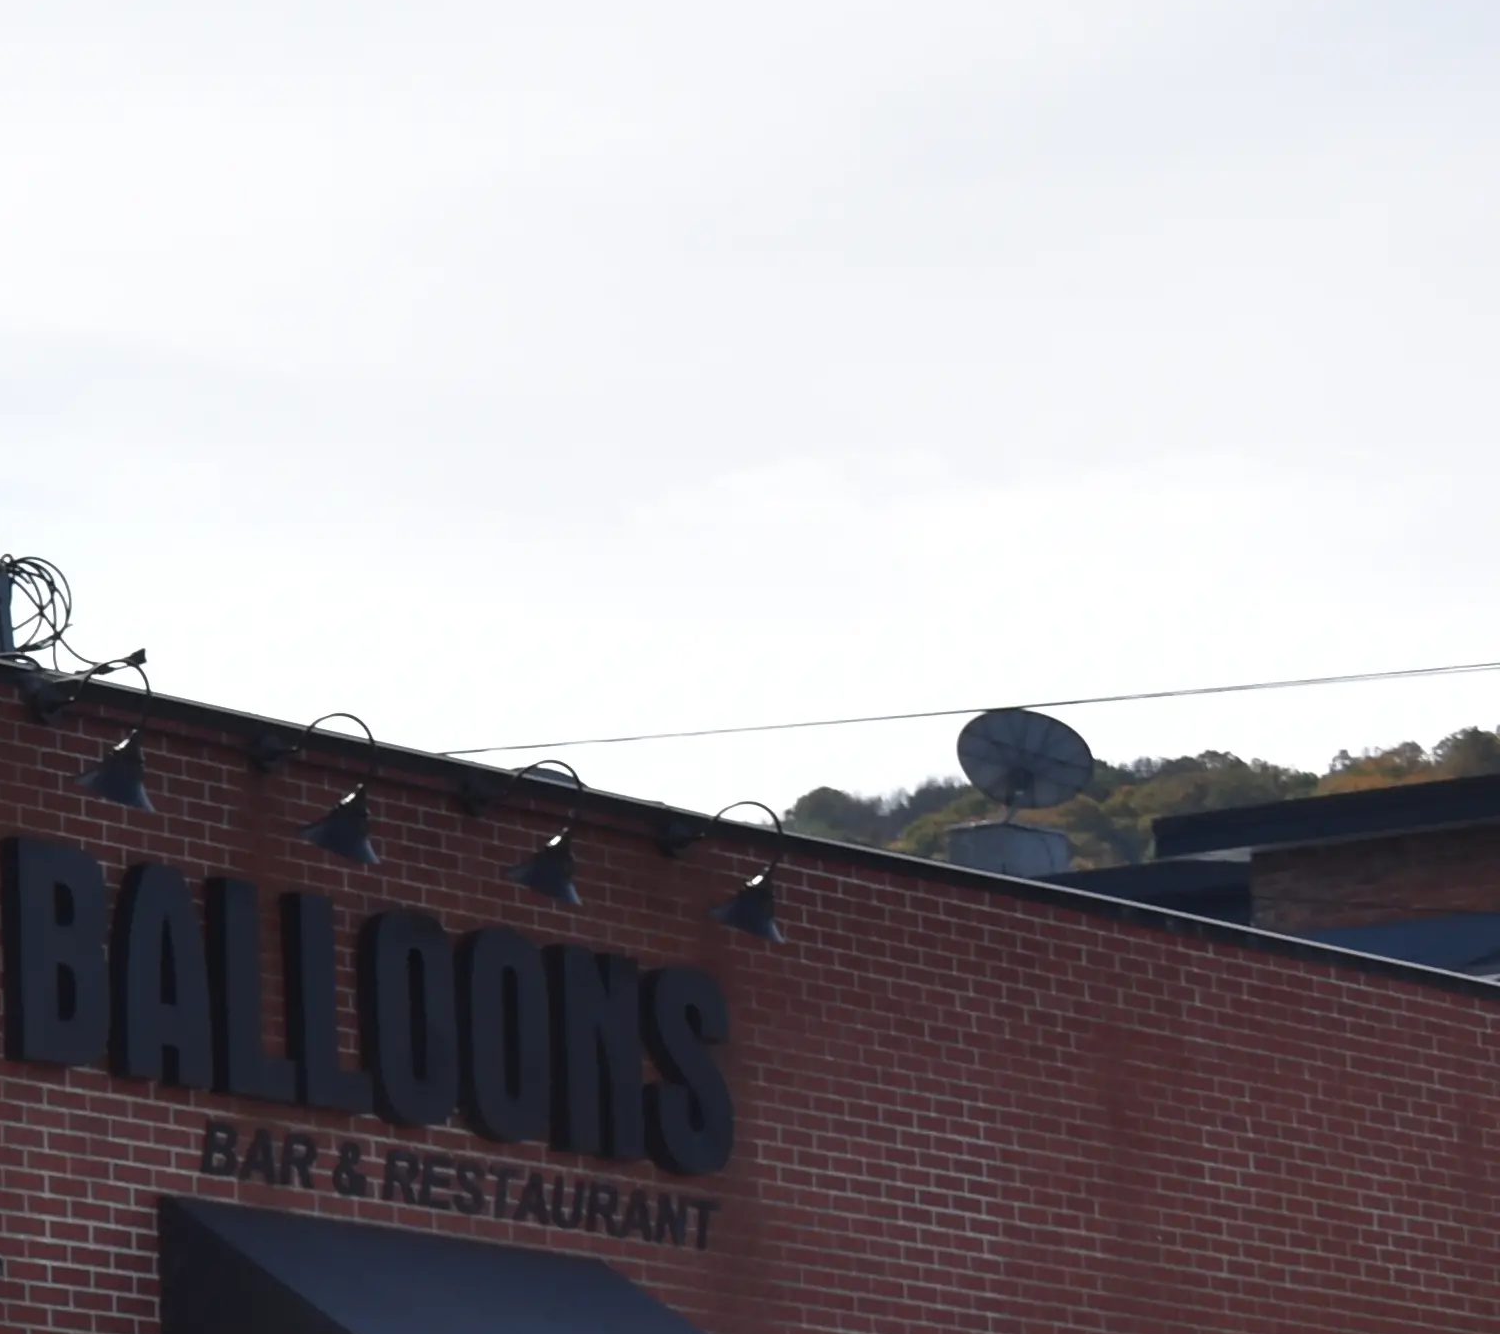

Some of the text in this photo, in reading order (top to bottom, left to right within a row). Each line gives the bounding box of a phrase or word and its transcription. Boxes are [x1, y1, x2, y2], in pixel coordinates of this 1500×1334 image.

[0, 835, 735, 1176] BALLOONS
[200, 1120, 719, 1251] BAR & RESTAURANT
